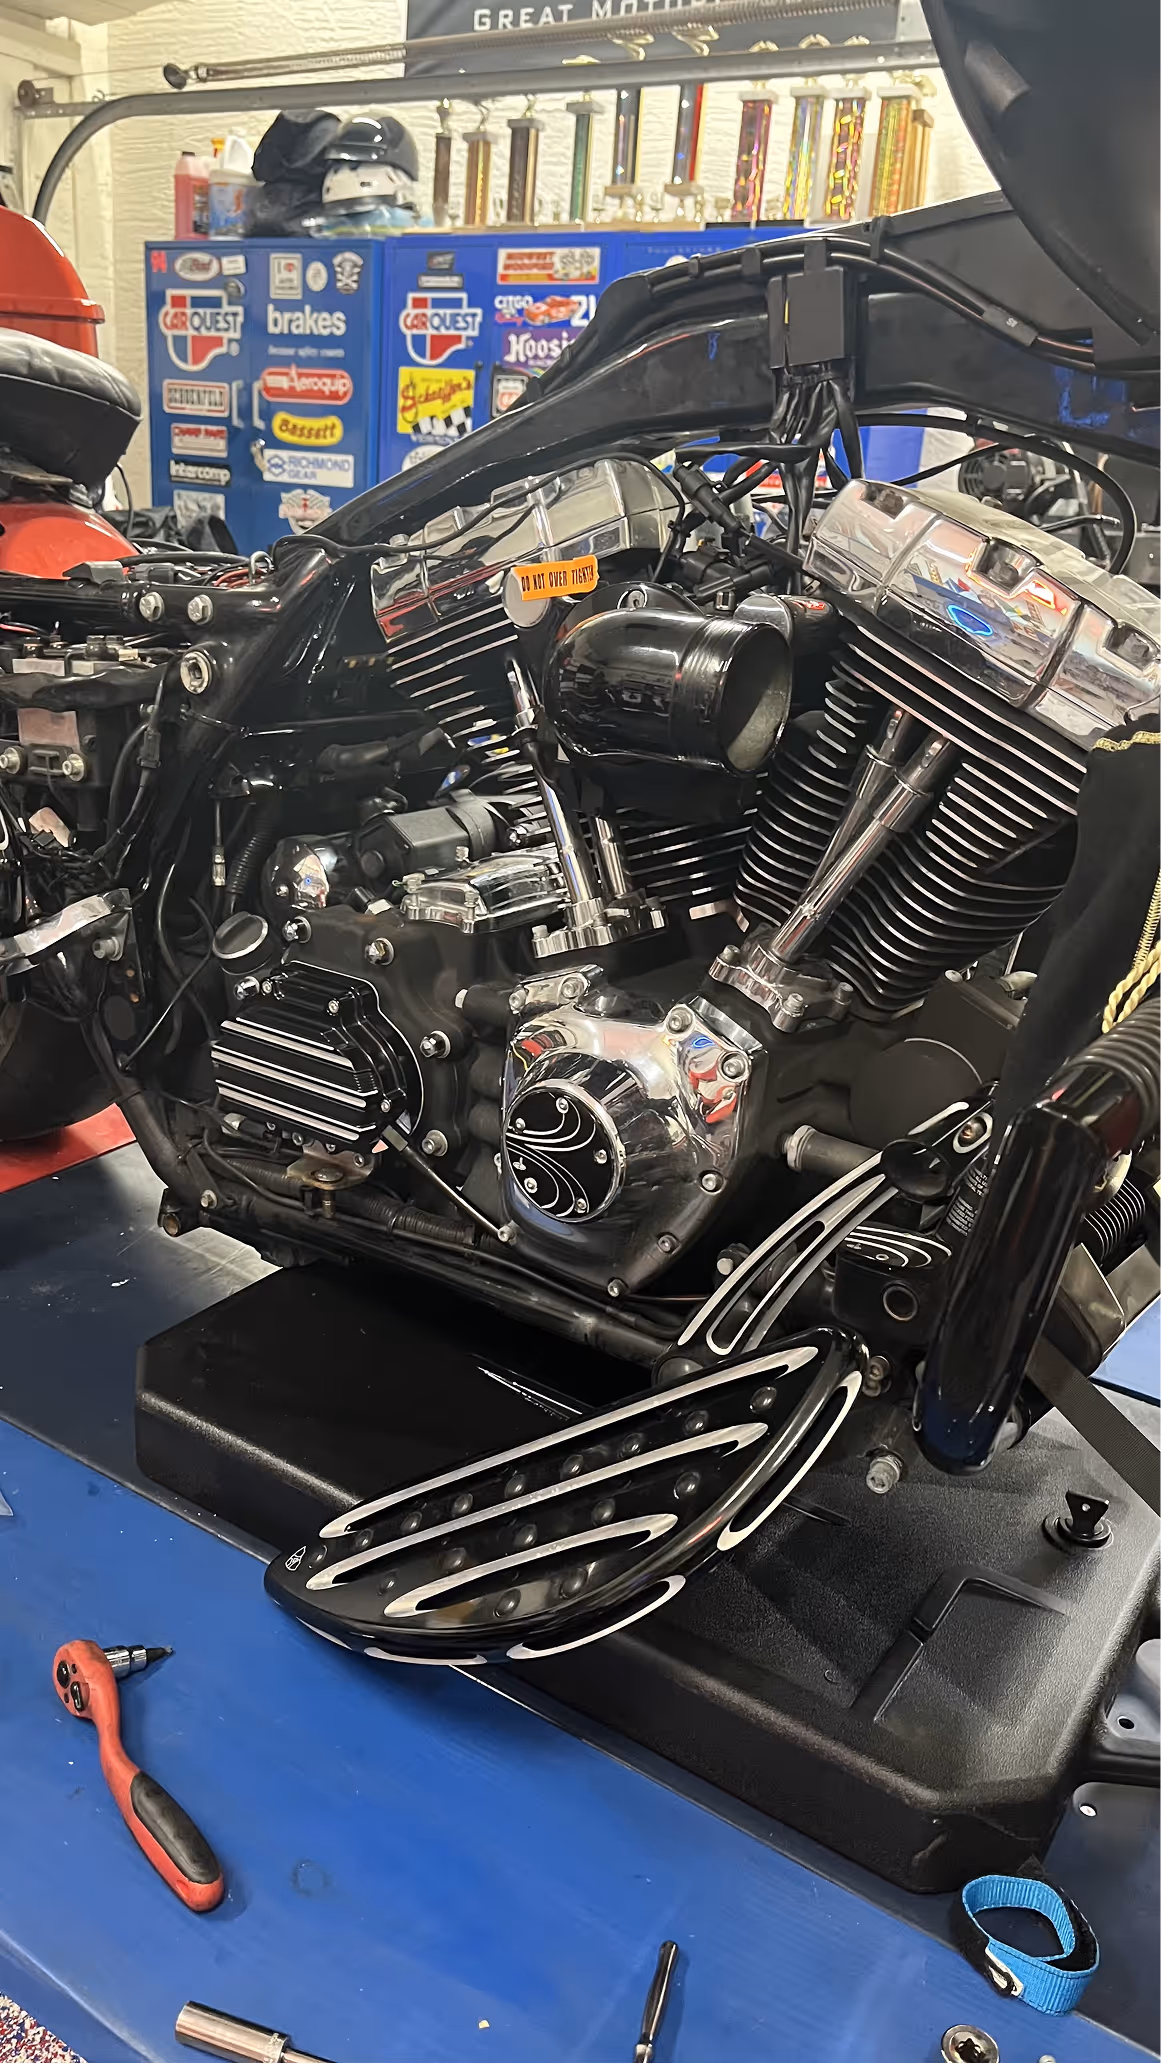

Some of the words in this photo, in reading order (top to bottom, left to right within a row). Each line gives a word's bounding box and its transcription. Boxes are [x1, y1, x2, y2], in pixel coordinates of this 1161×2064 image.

[473, 5, 574, 31] GREAT
[162, 310, 240, 334] CARQUEST
[267, 303, 347, 337] brakes
[403, 311, 479, 333] CARQUEST
[504, 330, 576, 363] Hoosi
[283, 362, 351, 396] Aeroquip
[279, 418, 336, 440] Bassett
[287, 456, 351, 473] RICHMOND
[287, 469, 318, 481] GEAR
[521, 575, 530, 592] DO
[532, 573, 546, 590] NOT
[548, 570, 568, 588] OVER
